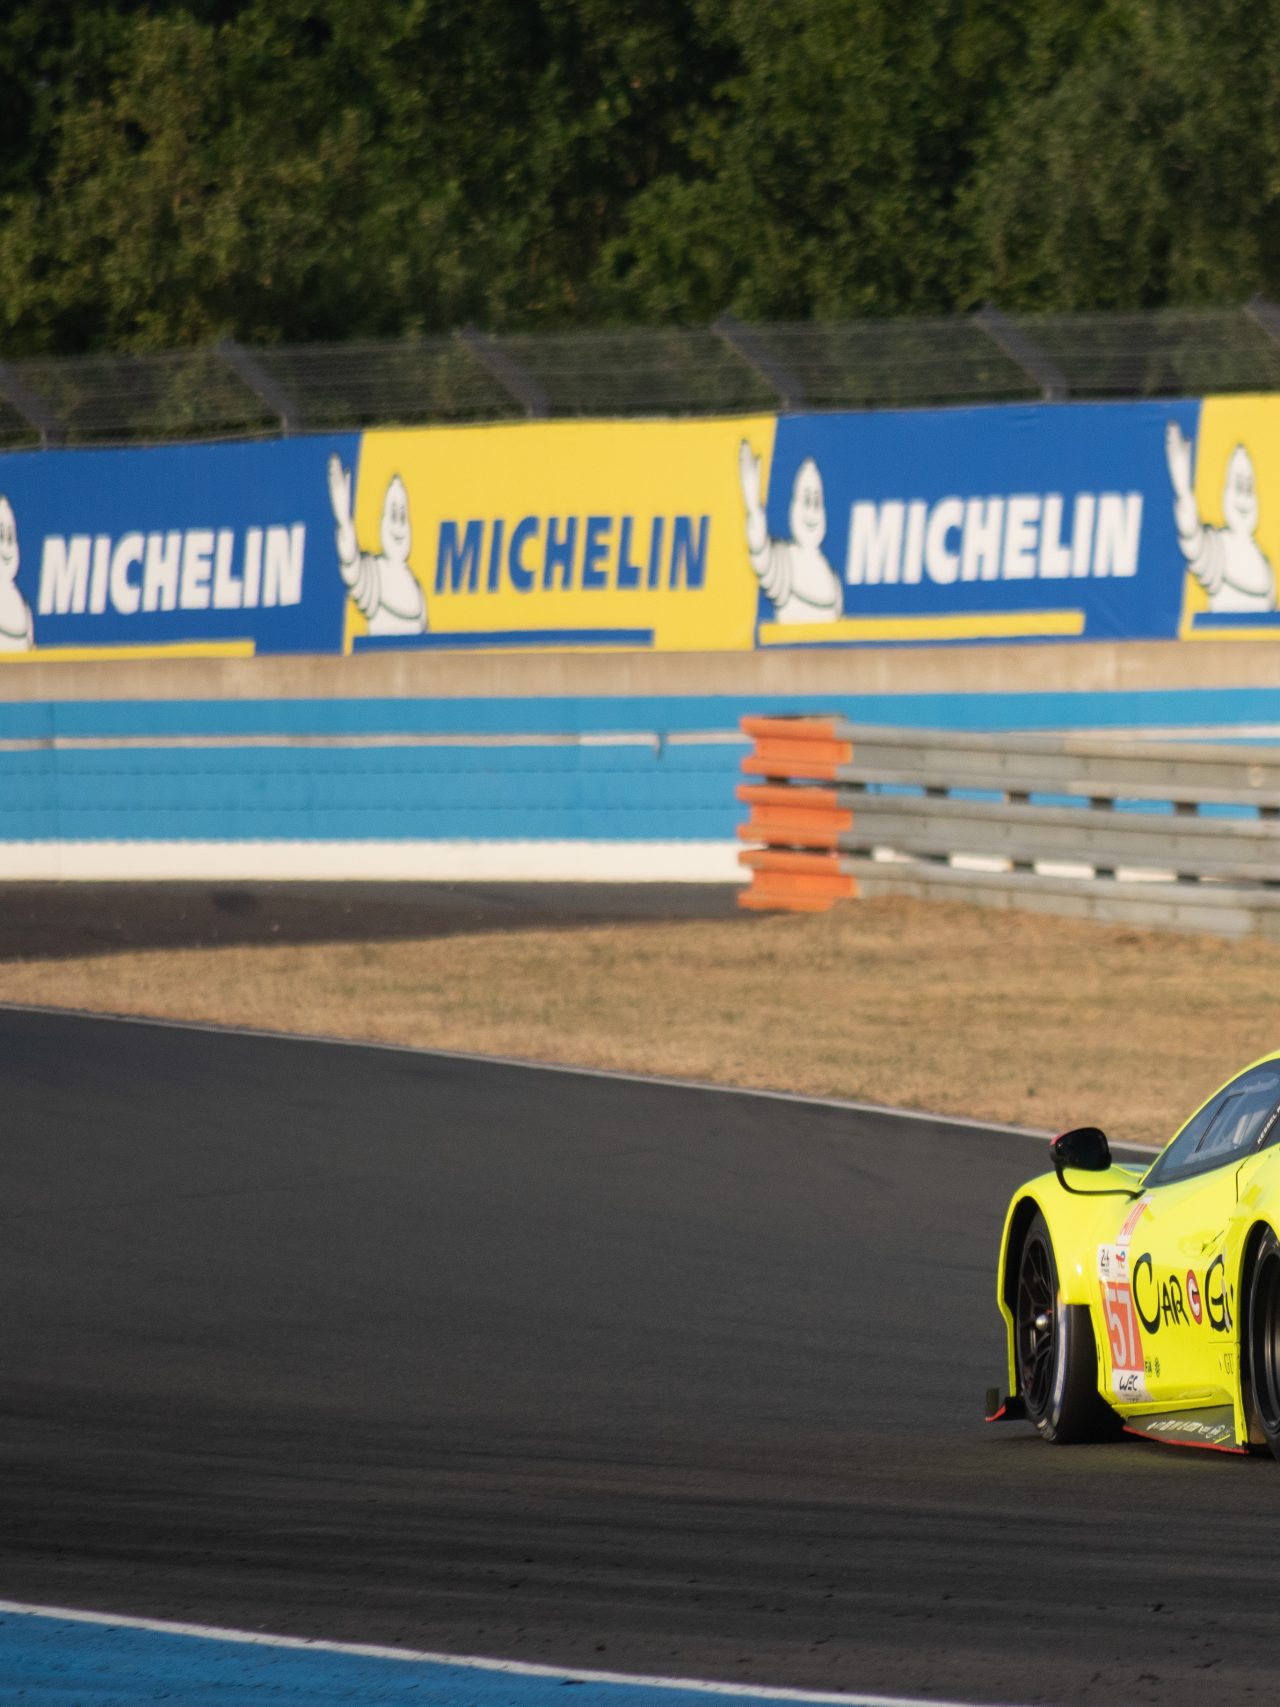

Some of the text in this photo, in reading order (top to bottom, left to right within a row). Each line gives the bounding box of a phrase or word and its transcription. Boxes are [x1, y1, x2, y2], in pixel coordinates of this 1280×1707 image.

[37, 523, 306, 615] MICHELIN
[434, 514, 711, 594] MICHELIN
[845, 491, 1143, 585] MICHELIN
[1256, 1111, 1277, 1144] KESSEL
[1105, 1286, 1137, 1369] 57
[1119, 1374, 1139, 1392] WEC
